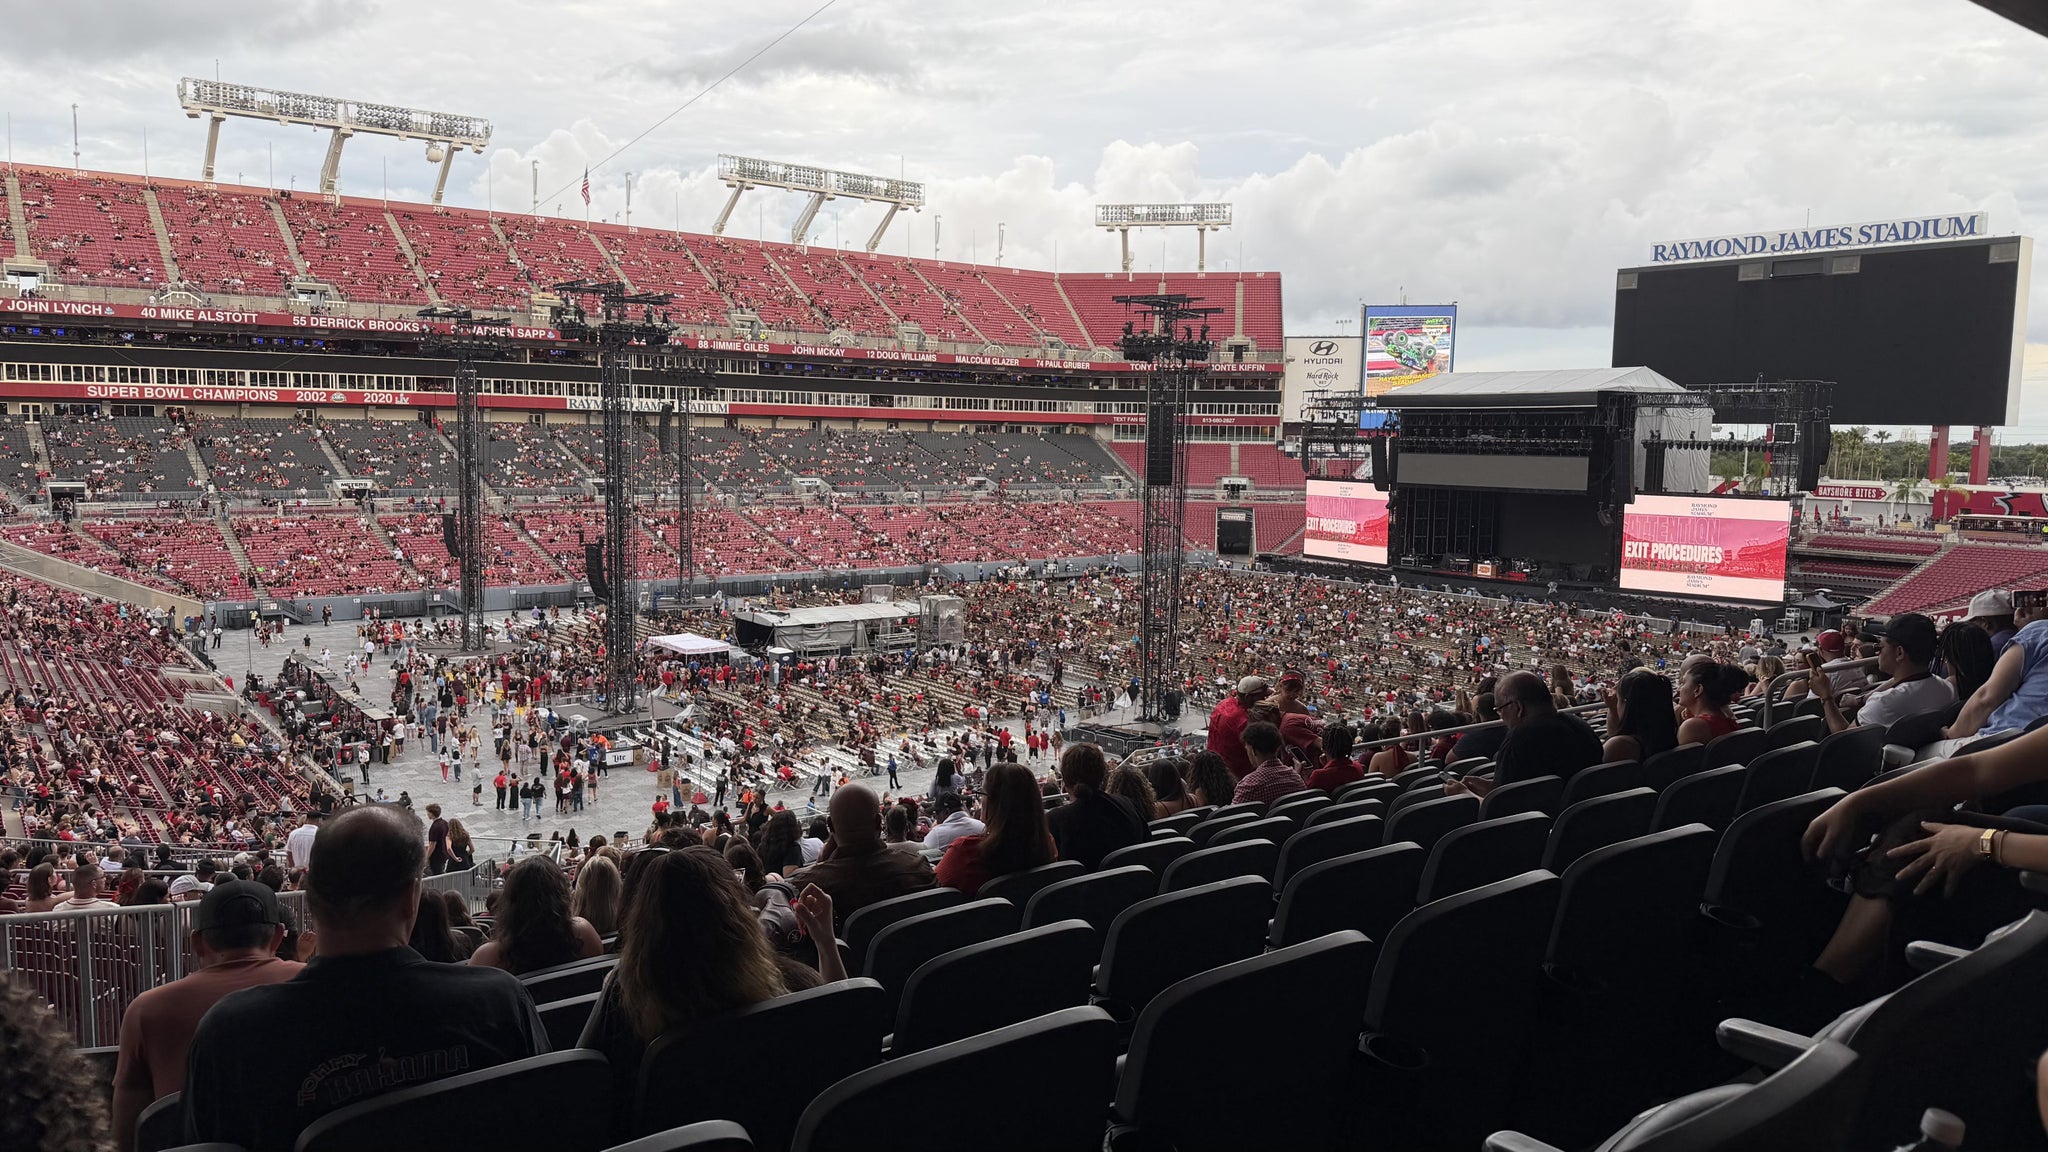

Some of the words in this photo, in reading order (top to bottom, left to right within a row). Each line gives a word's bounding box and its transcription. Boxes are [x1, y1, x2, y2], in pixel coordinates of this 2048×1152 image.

[1652, 236, 1766, 261] RAYMOND
[1770, 227, 1852, 252] JAMES
[1857, 215, 1978, 244] STADIUM
[7, 300, 49, 312] JOHN
[53, 302, 102, 315] LYNCH
[141, 308, 156, 318] 40
[160, 309, 194, 320] MIKE
[198, 310, 258, 323] ALSTOTT
[292, 316, 307, 326] 55
[310, 317, 365, 330] DERRICK
[368, 320, 419, 332] BROOKS
[517, 328, 546, 338] SAPP
[698, 340, 709, 349] 88
[710, 341, 741, 351] JIMMIE
[743, 342, 769, 352] GILES
[792, 345, 814, 355] JOHN
[816, 346, 845, 357] MCKAY
[866, 350, 875, 358] 12
[876, 351, 899, 360] DOUG
[901, 353, 937, 362] WILLIAMS
[955, 355, 991, 365] MALCOLM
[992, 357, 1019, 366] GLAZER
[1036, 359, 1044, 367] 74
[1045, 360, 1062, 368] PAUL
[1063, 362, 1090, 370] GRUBER
[1130, 363, 1151, 371] TONY
[1306, 372, 1323, 380] Hard
[1323, 372, 1339, 381] Rock
[87, 386, 140, 398] SUPER
[144, 387, 189, 399] BOWL
[193, 388, 278, 401] CHAMPIONS
[296, 391, 327, 402] 2002
[364, 392, 392, 403] 2020
[569, 398, 634, 410] RAYM
[1818, 486, 1853, 497] BAYSHORE
[1855, 488, 1876, 498] BITES
[1307, 516, 1319, 531] EXIT
[1320, 518, 1356, 534] PROCEDURES
[1626, 515, 1720, 546] ATTENTION
[1624, 541, 1649, 558] EXIT
[1650, 542, 1722, 564] PROCEDURES
[297, 1053, 367, 1106] TOMMY
